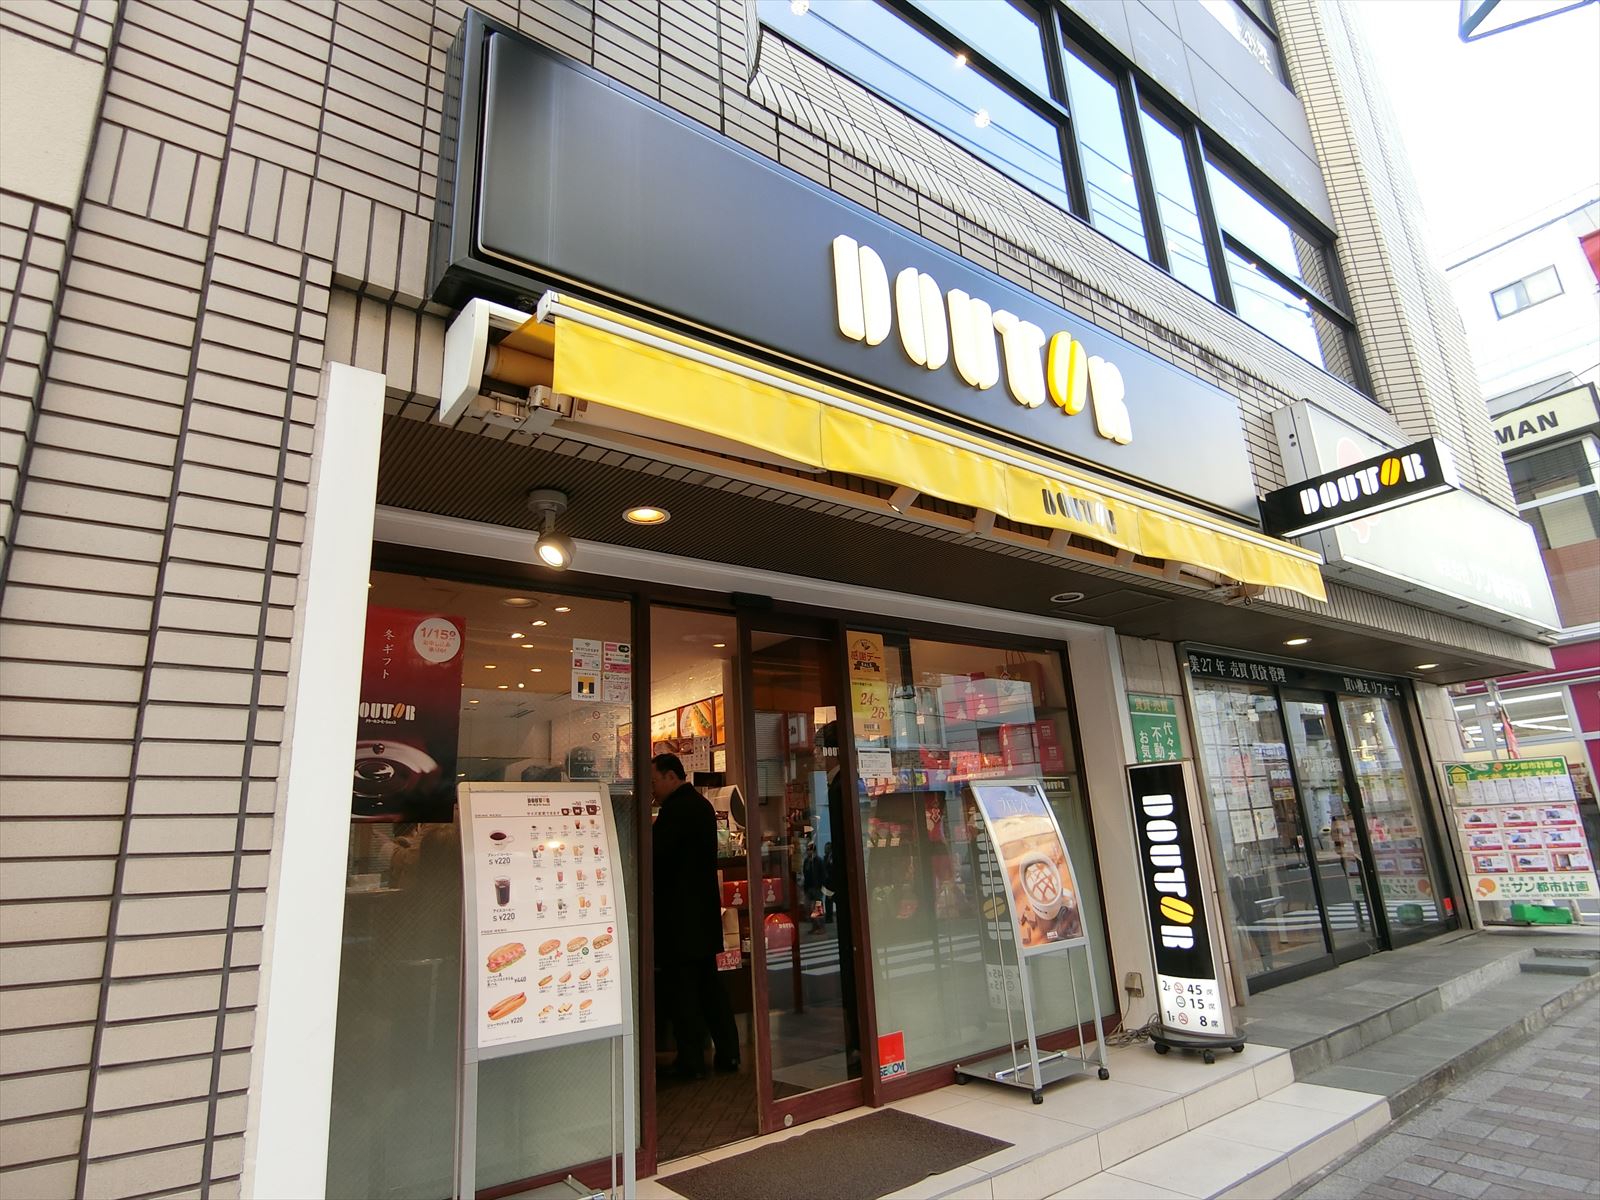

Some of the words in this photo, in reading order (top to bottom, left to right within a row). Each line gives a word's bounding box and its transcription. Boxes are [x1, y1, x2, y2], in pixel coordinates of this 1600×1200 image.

[832, 234, 1133, 445] DOUTOR
[1493, 410, 1559, 444] MAN
[1299, 452, 1426, 515] DOUTOR
[1041, 488, 1117, 534] DOUTOR
[382, 628, 395, 679] 冬ギフト
[1229, 660, 1249, 679] 売買
[1370, 681, 1400, 696] リフォーム
[1151, 726, 1165, 761] 不動
[495, 856, 511, 864] ¥220
[1142, 794, 1195, 950] DOUTOR
[1511, 881, 1589, 893] サン都市計画
[499, 912, 516, 921] ¥220
[1187, 984, 1203, 995] 45
[1189, 998, 1205, 1010] 15
[1199, 1015, 1208, 1027] 8
